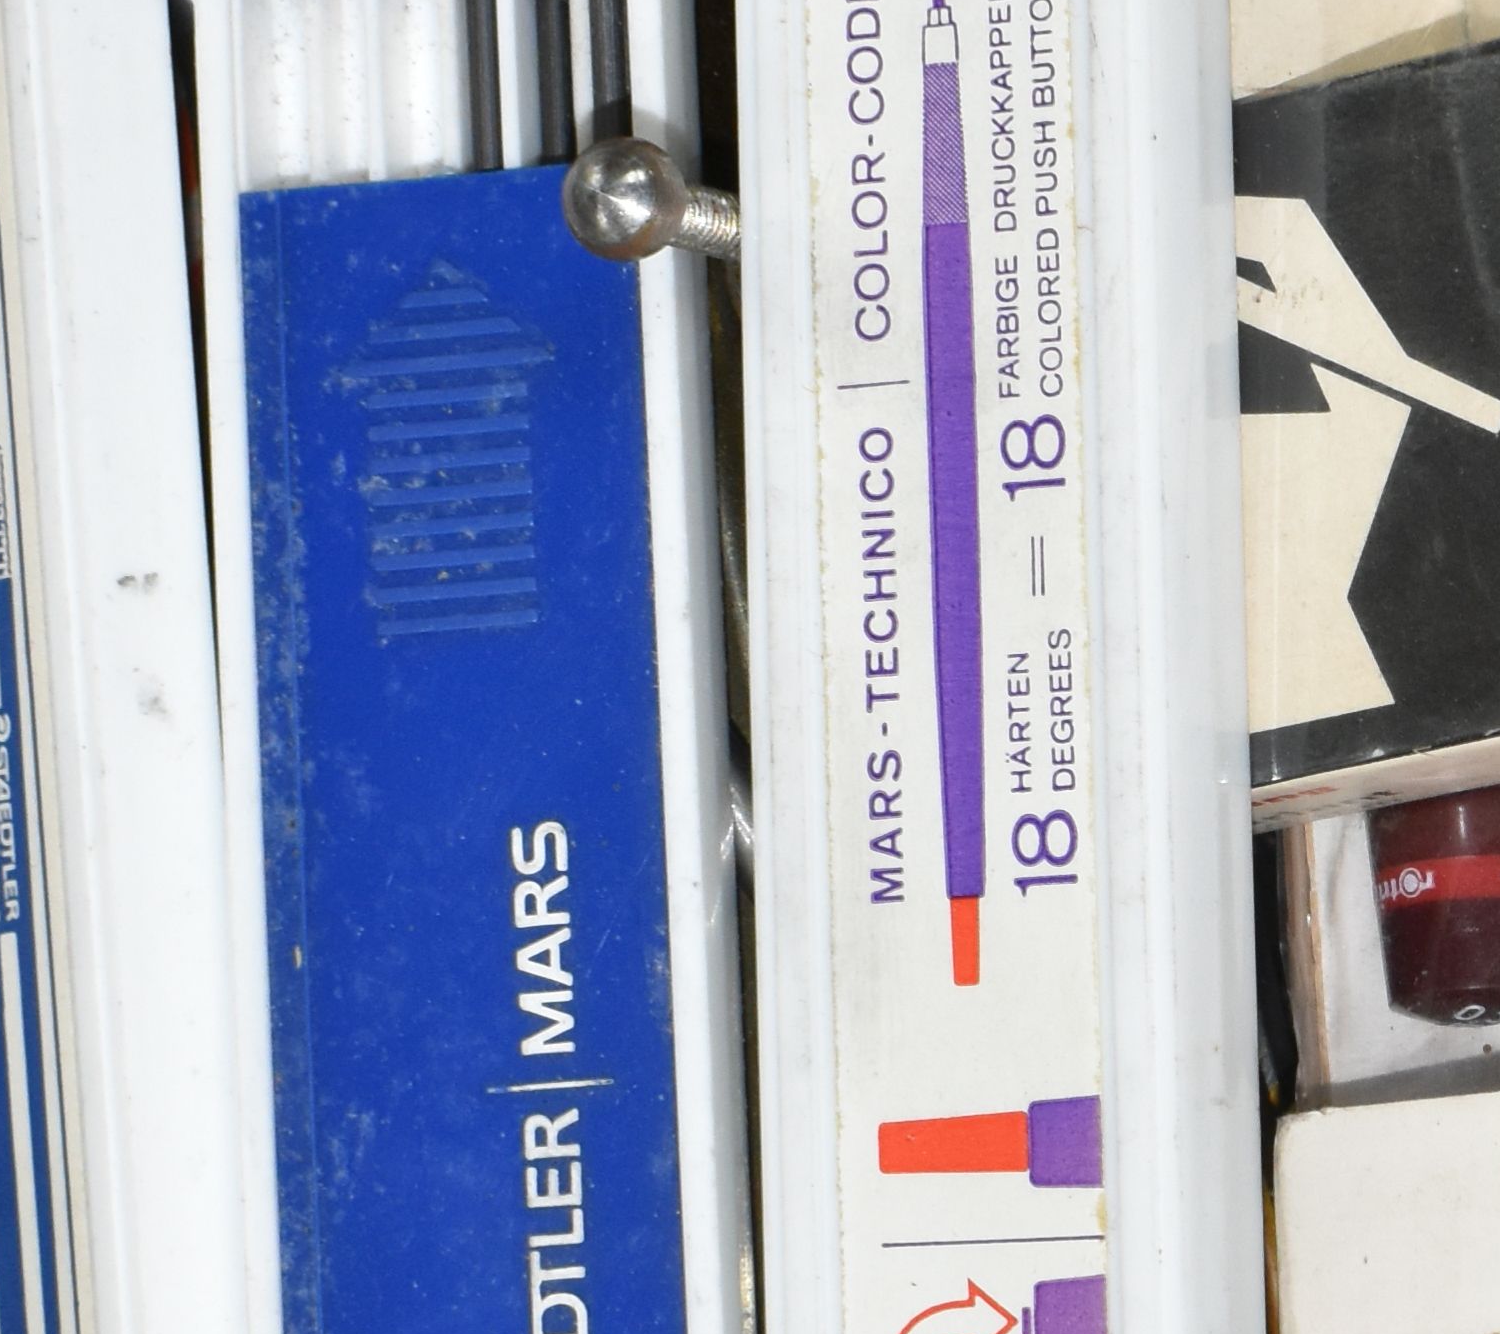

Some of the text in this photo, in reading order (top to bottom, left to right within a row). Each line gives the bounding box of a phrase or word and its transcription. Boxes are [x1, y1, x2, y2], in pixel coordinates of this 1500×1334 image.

[1031, 118, 1059, 218] PUSH
[993, 253, 1021, 400] FARBIGE
[1035, 225, 1064, 399] COLORED
[999, 412, 1067, 502] 18
[1006, 650, 1079, 897] 18 HÄRTEN
[1047, 627, 1076, 793] DEGREES
[510, 819, 576, 1057] MARS
